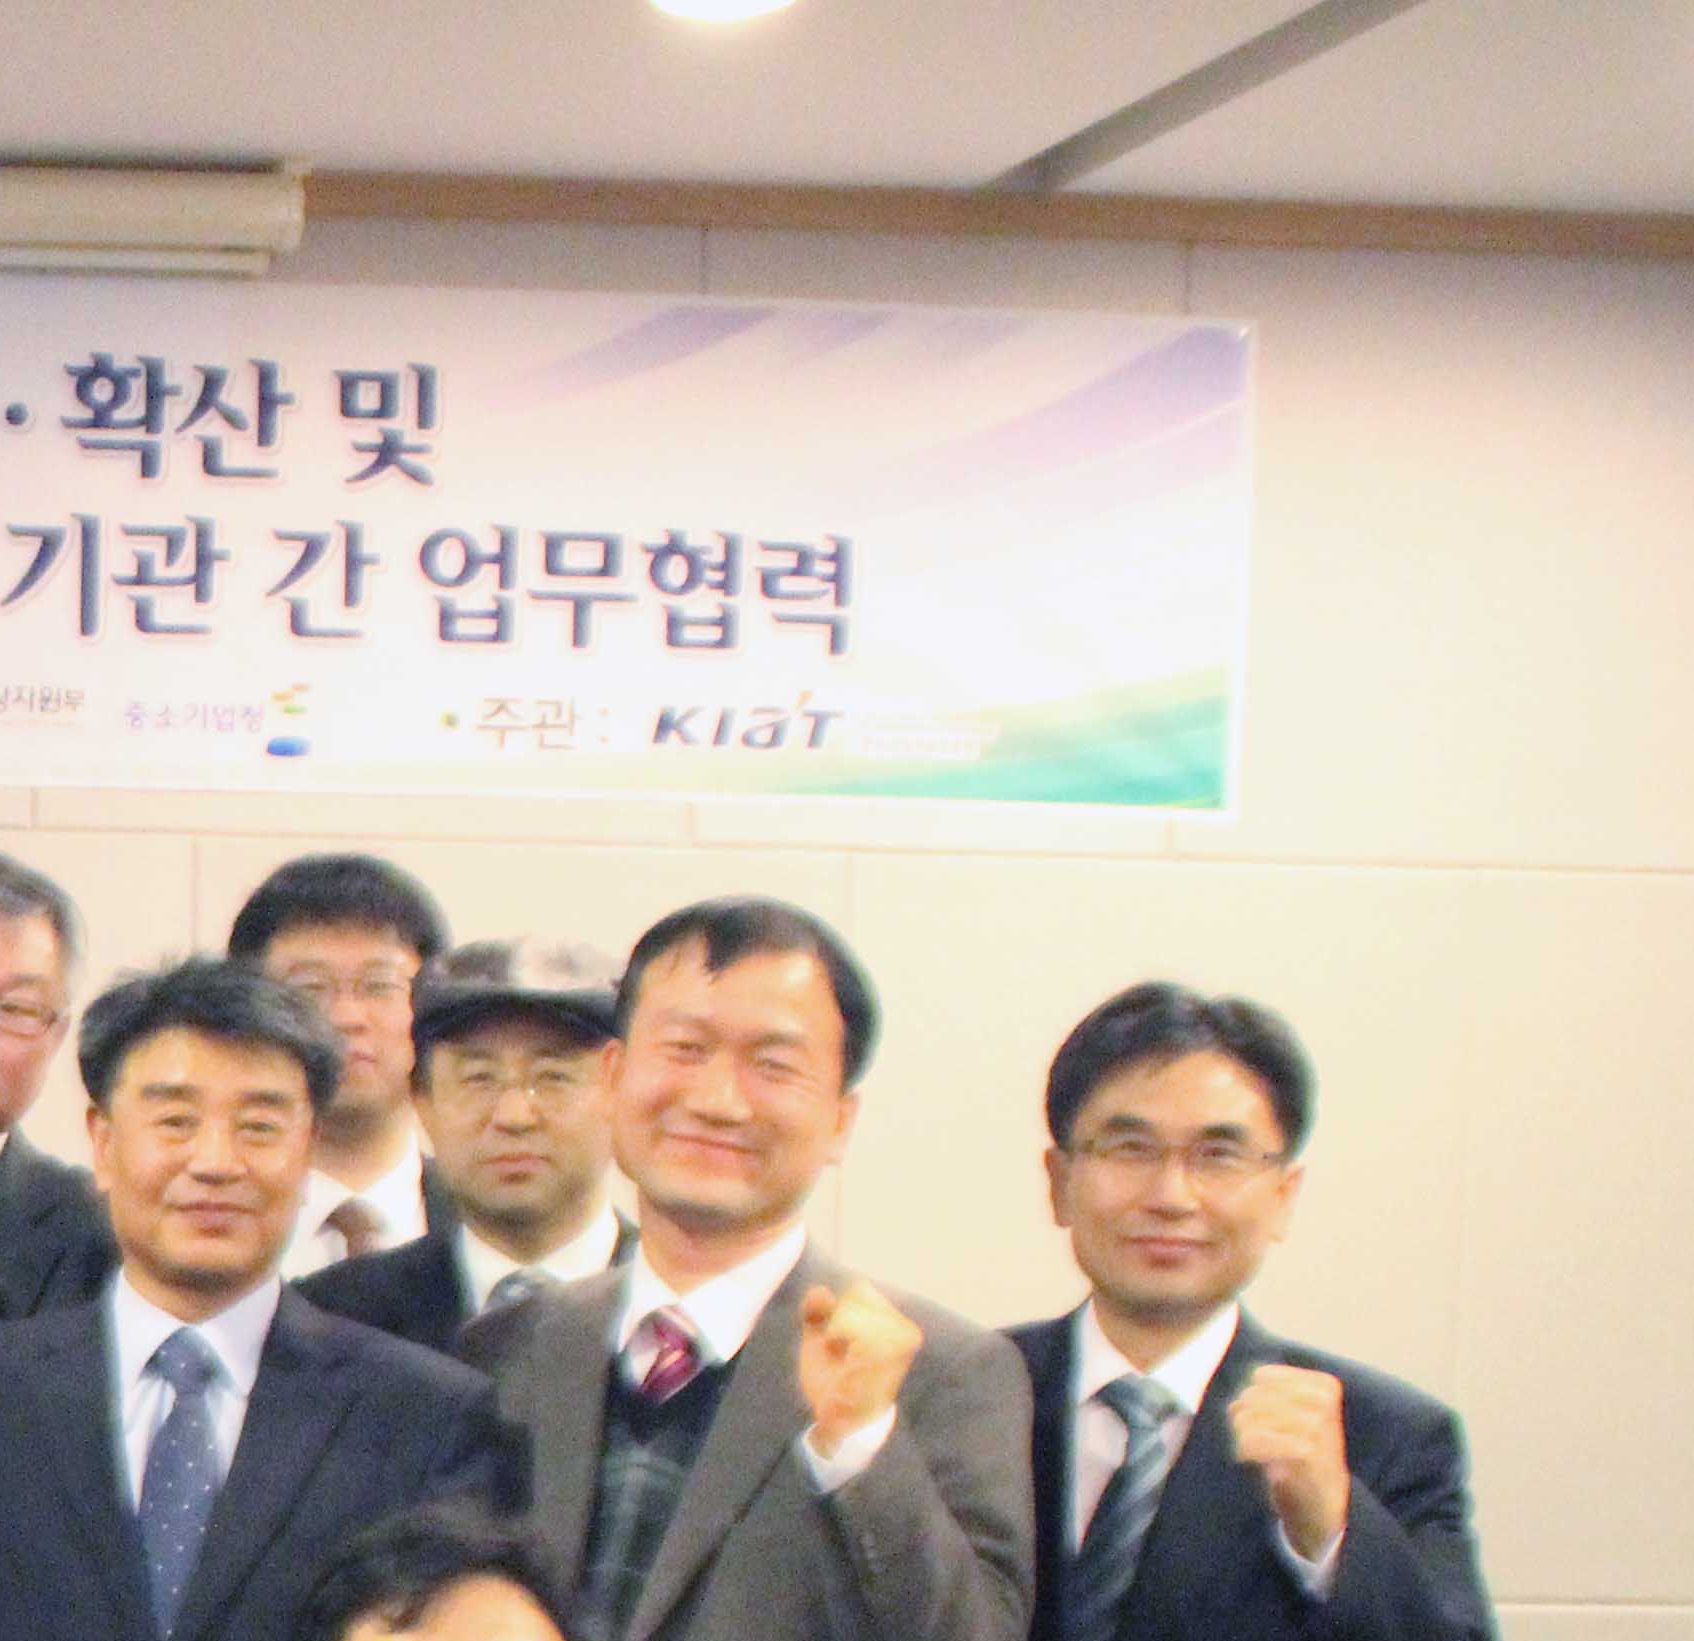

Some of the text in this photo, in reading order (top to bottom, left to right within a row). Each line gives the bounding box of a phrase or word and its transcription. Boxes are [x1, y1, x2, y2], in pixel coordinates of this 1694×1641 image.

[331, 361, 438, 487] 및
[0, 512, 232, 638] 기관
[268, 519, 383, 640] 간
[416, 522, 855, 656] 업무협력
